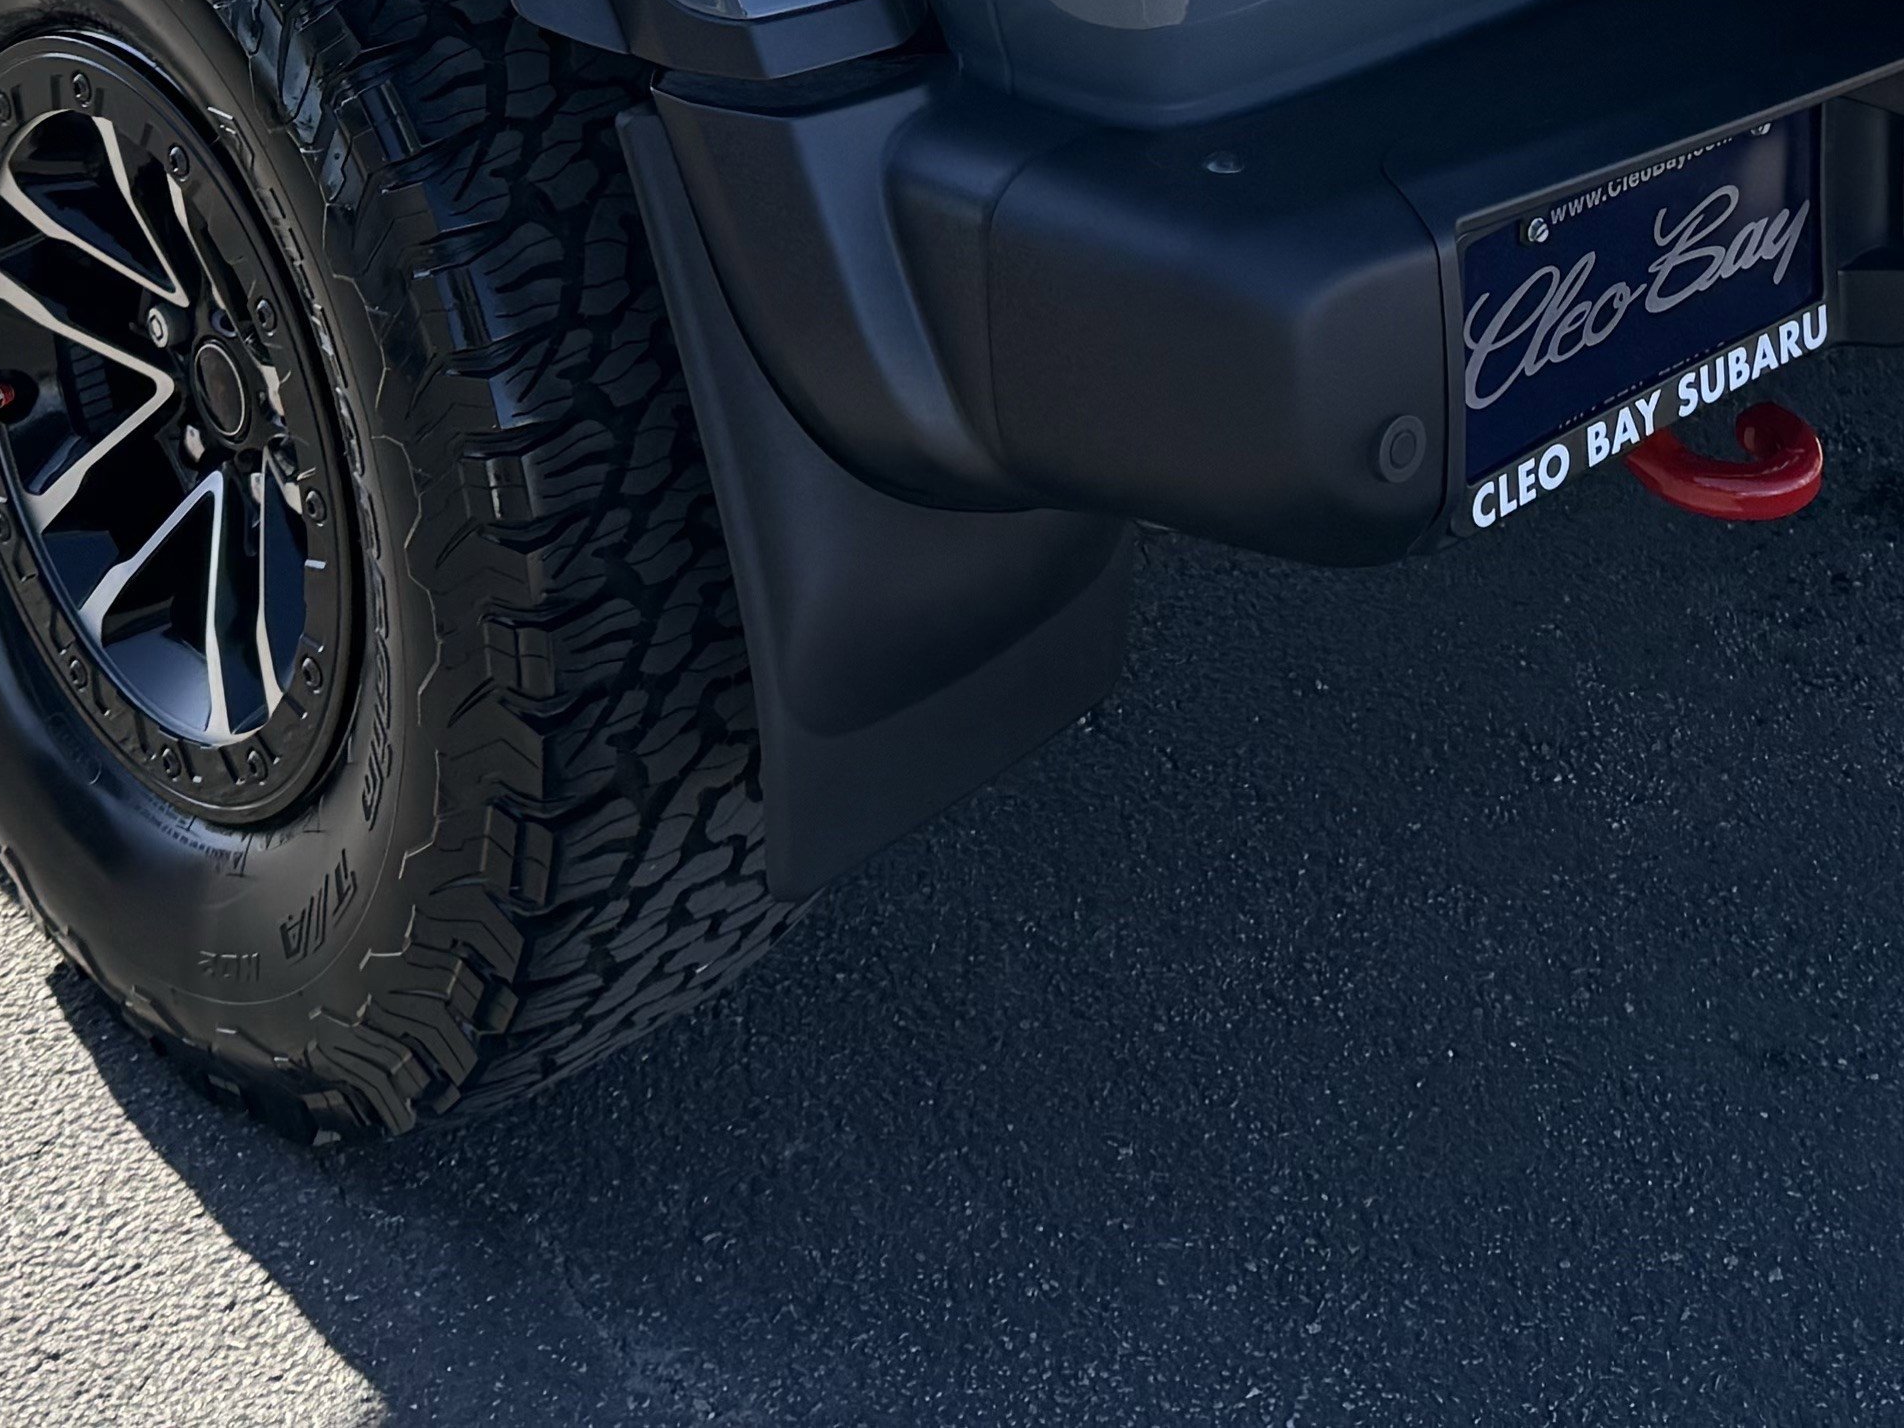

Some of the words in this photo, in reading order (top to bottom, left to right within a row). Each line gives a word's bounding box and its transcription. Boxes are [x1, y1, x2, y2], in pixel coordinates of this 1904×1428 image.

[1463, 251, 1647, 410] Cleo
[1645, 184, 1810, 313] Bay
[1472, 443, 1571, 529] CLEO
[1586, 389, 1662, 469] BAY
[1677, 304, 1828, 418] SUBARU
